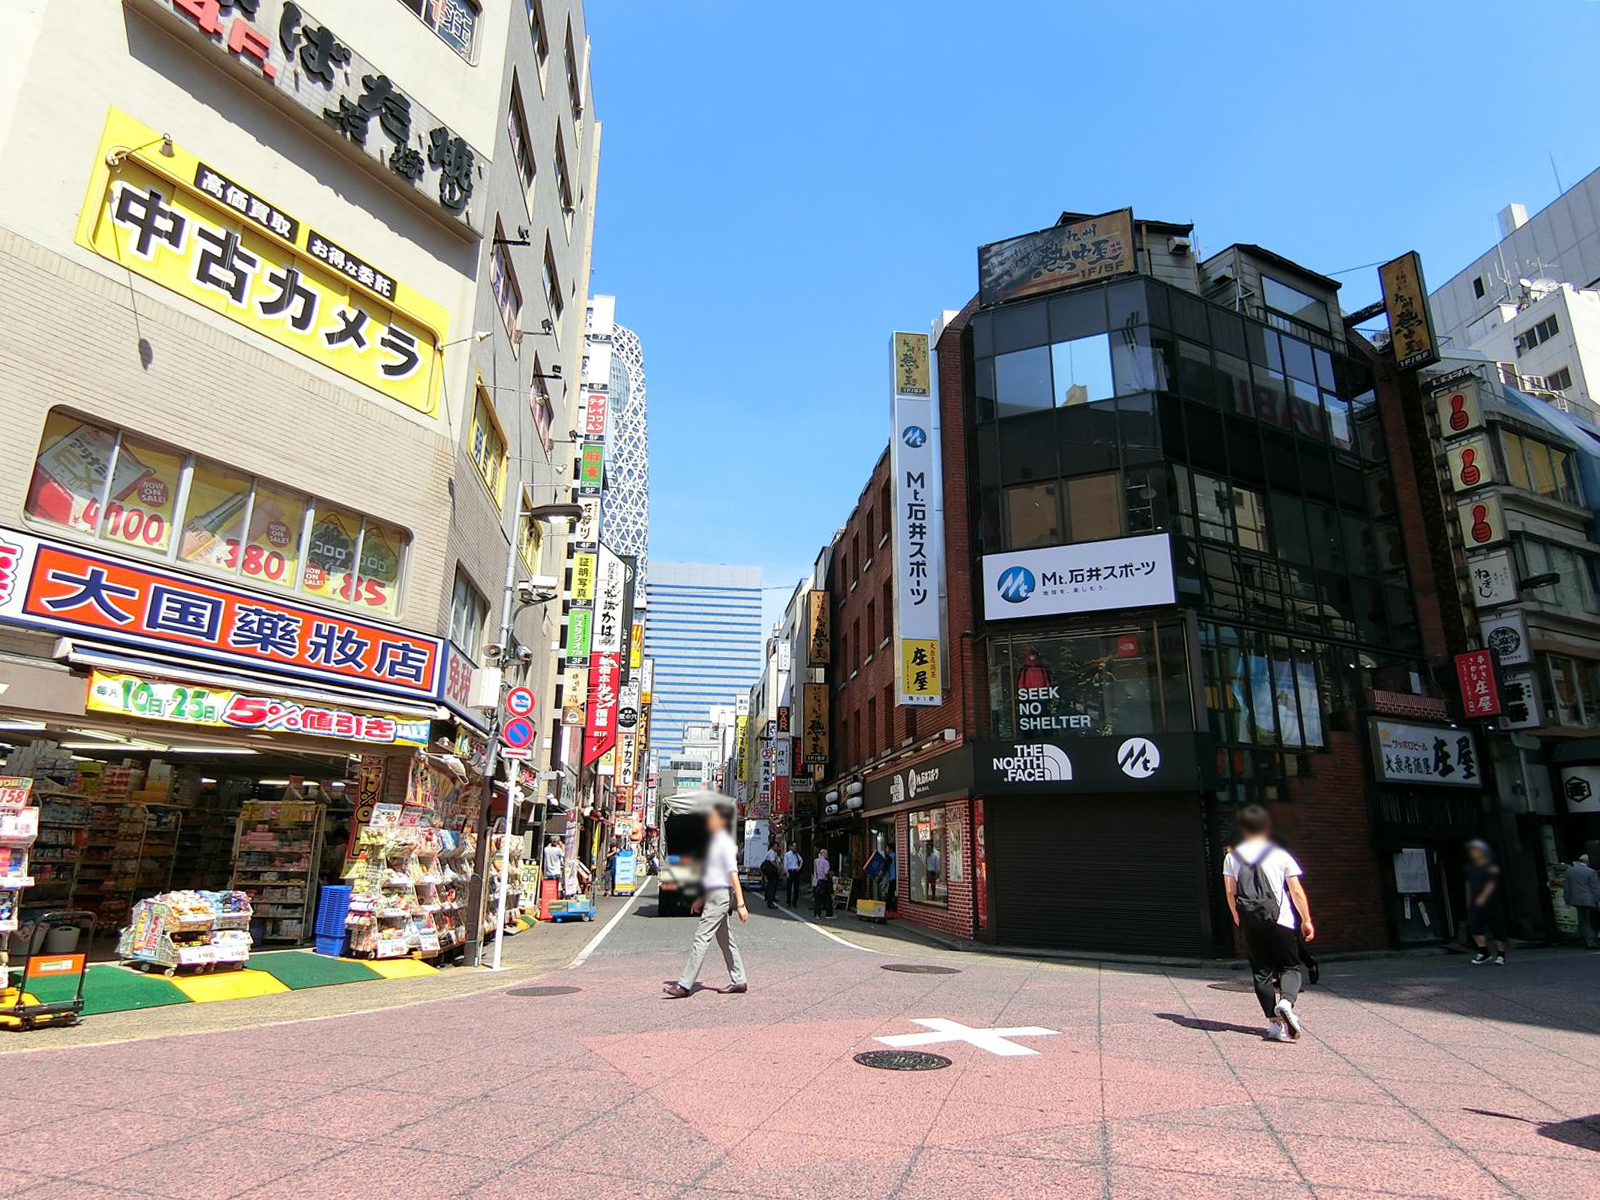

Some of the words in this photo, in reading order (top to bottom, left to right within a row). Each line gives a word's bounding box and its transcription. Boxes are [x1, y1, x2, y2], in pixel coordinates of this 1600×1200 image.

[199, 171, 293, 240] 高価買取
[112, 185, 421, 378] 中古カメラ
[310, 238, 393, 298] お得な委託
[906, 471, 928, 606] Mt.石井スポーツ
[577, 557, 590, 598] 証明写真
[1041, 560, 1156, 587] Mt.石井スポーツ
[911, 647, 929, 691] 庄屋
[1018, 686, 1060, 700] SEEK
[1019, 702, 1042, 716] NO
[1474, 680, 1493, 712] 庄屋
[225, 697, 396, 740] 5%値引き
[779, 708, 788, 731] BAR
[1019, 715, 1091, 731] SHELTER
[622, 739, 634, 785] チカラめし
[993, 756, 1043, 770] NORTH
[1014, 744, 1043, 757] THE
[1386, 753, 1433, 775] 大衆居酒屋
[1433, 736, 1477, 780] 庄屋
[1007, 769, 1044, 782] FACE
